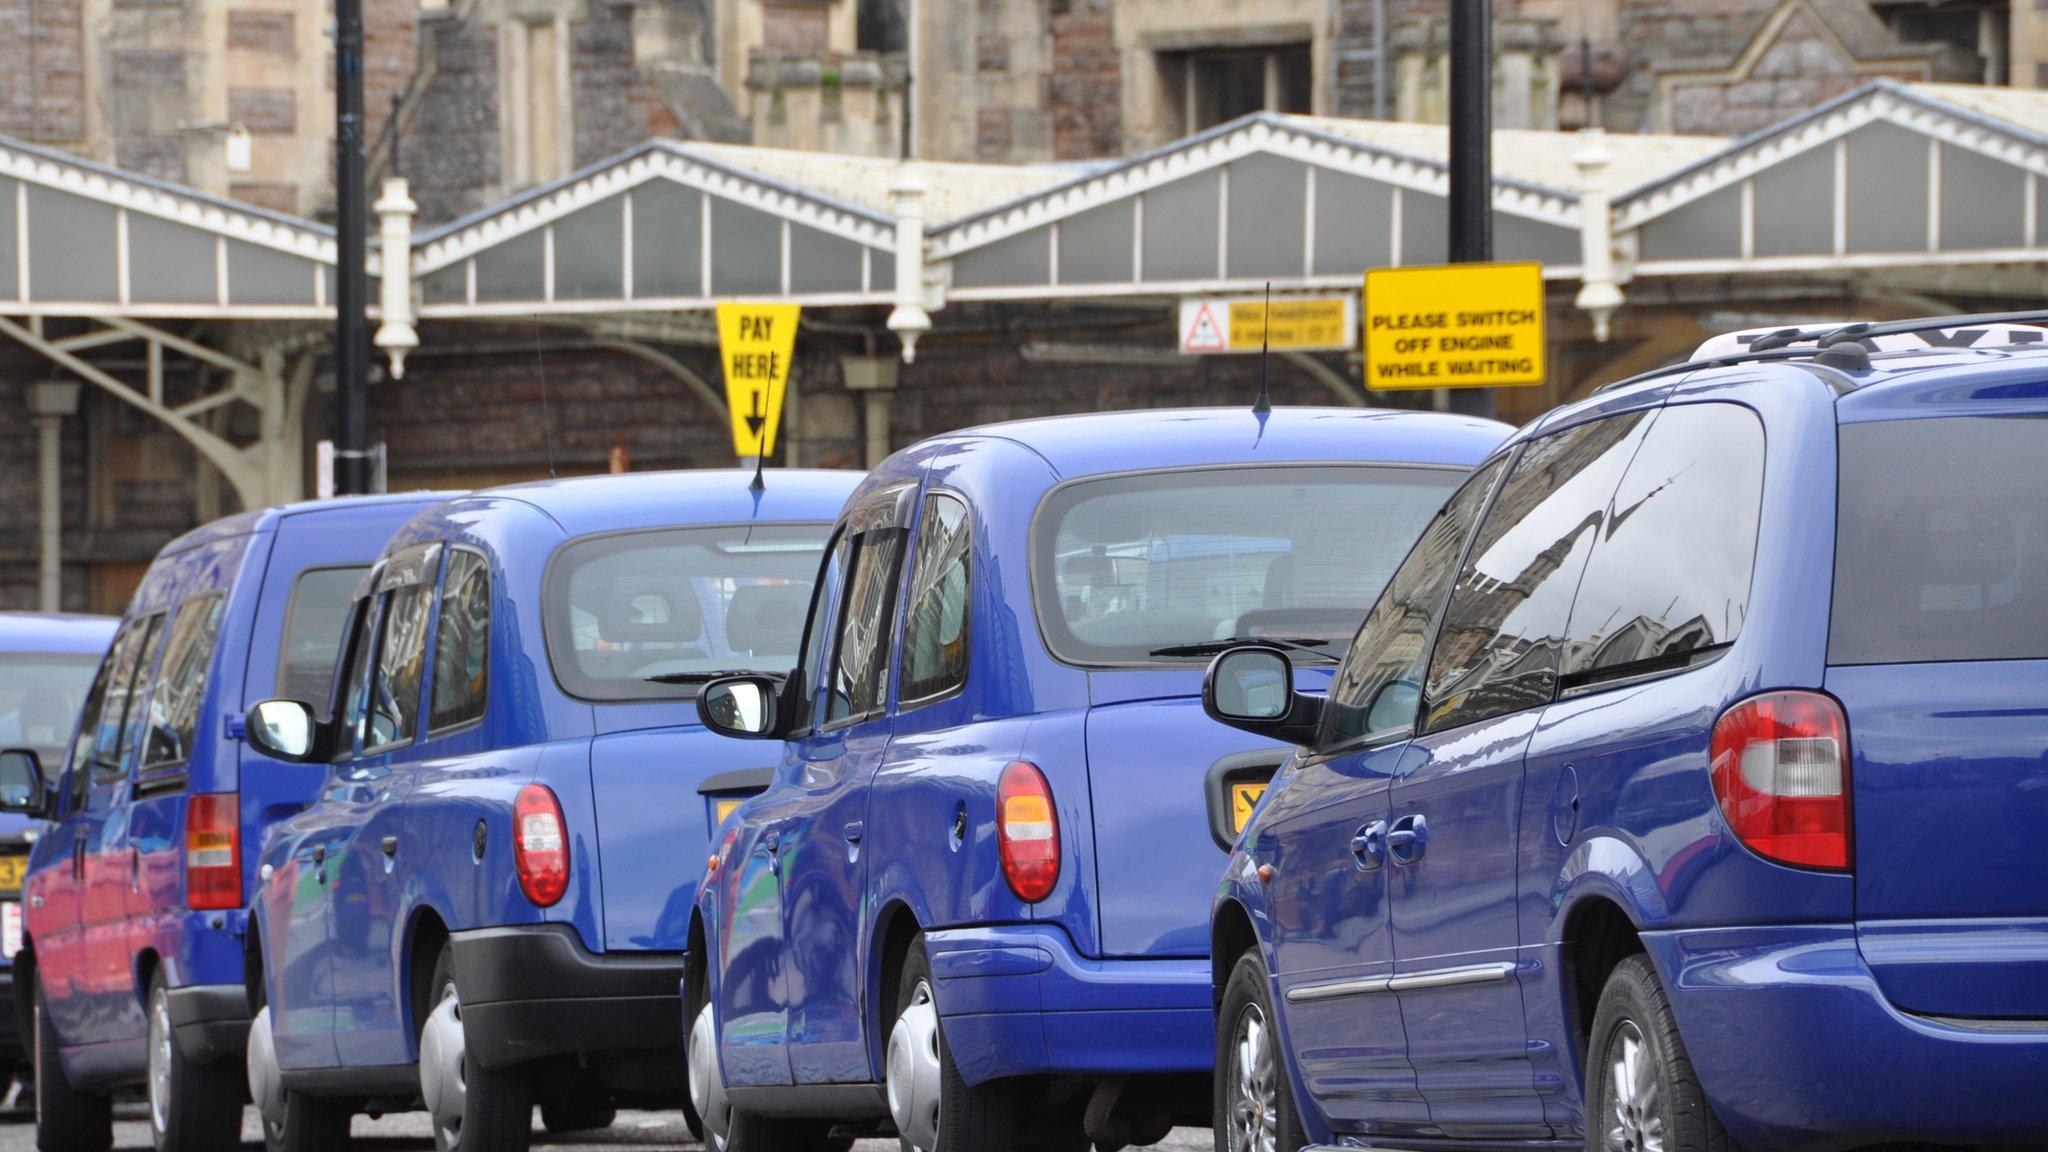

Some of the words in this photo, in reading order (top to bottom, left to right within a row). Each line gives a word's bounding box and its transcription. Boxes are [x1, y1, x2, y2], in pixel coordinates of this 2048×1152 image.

[740, 315, 773, 341] PAY
[1373, 312, 1448, 331] PLEASE
[1456, 309, 1535, 328] SWITCH
[1394, 337, 1431, 354] OFF
[1440, 335, 1513, 352] ENGINE
[733, 354, 780, 379] HERE
[1377, 361, 1439, 378] WHILE
[1448, 358, 1532, 375] WAITING
